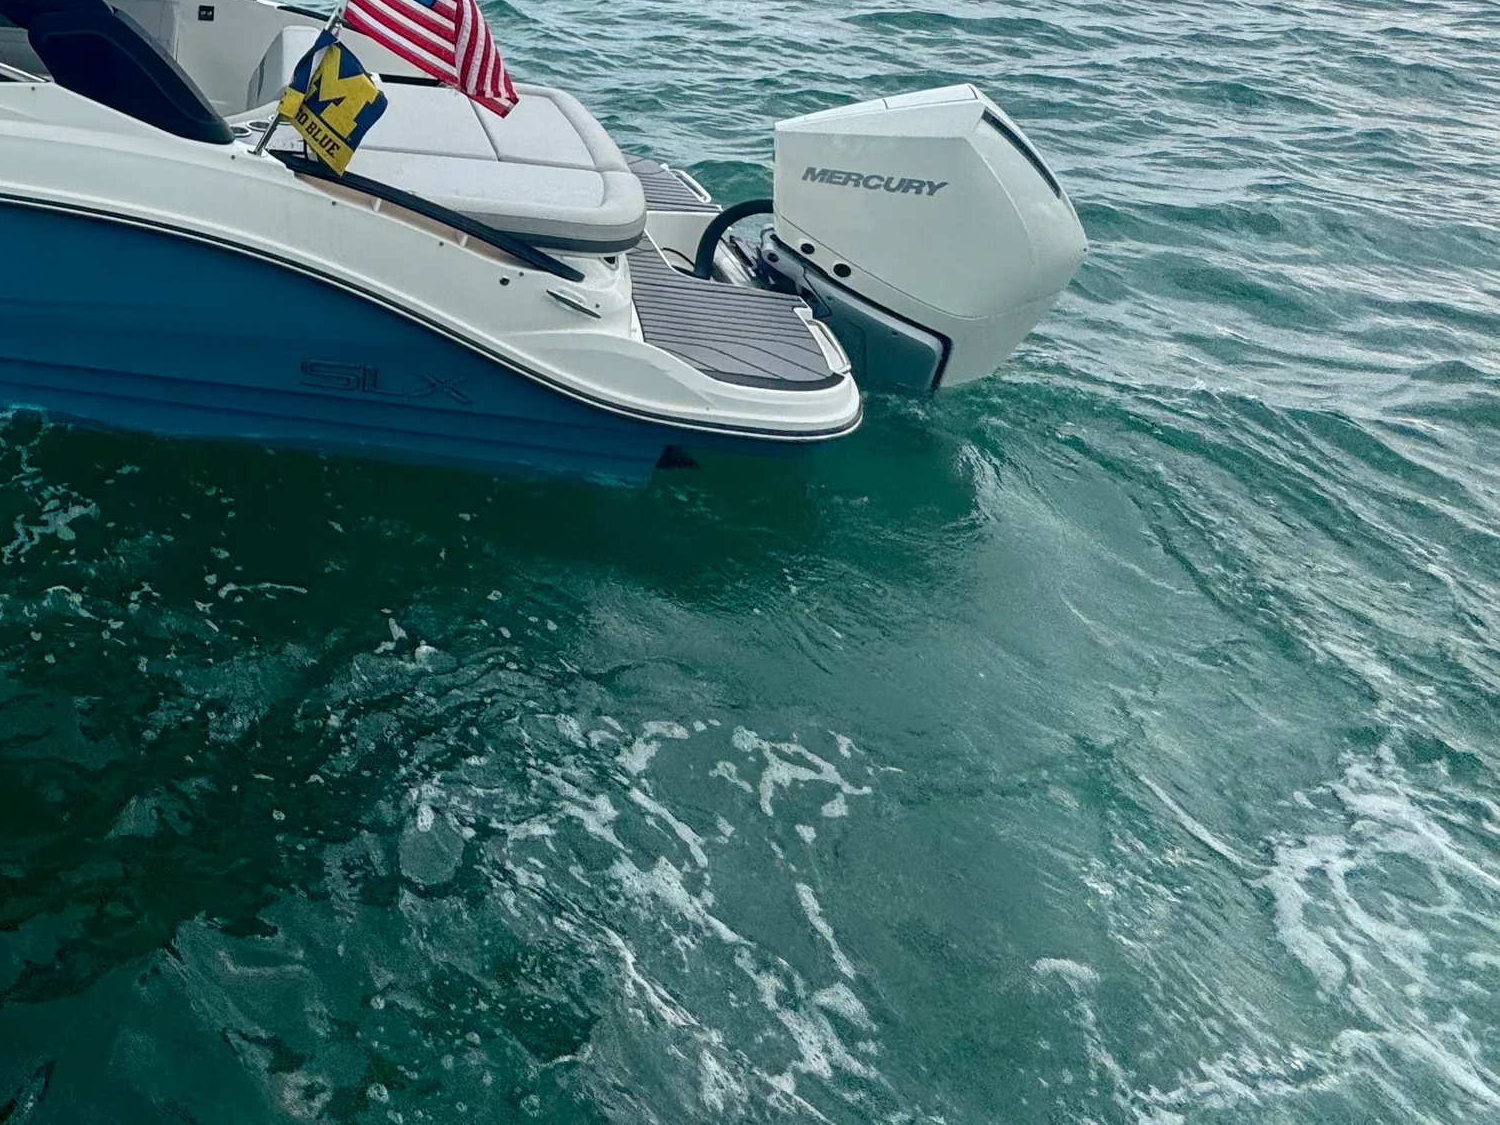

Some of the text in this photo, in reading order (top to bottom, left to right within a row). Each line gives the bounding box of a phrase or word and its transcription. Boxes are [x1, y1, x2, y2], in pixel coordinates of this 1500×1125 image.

[304, 43, 379, 139] M
[801, 166, 950, 196] MERCURY
[300, 358, 475, 405] SLX
